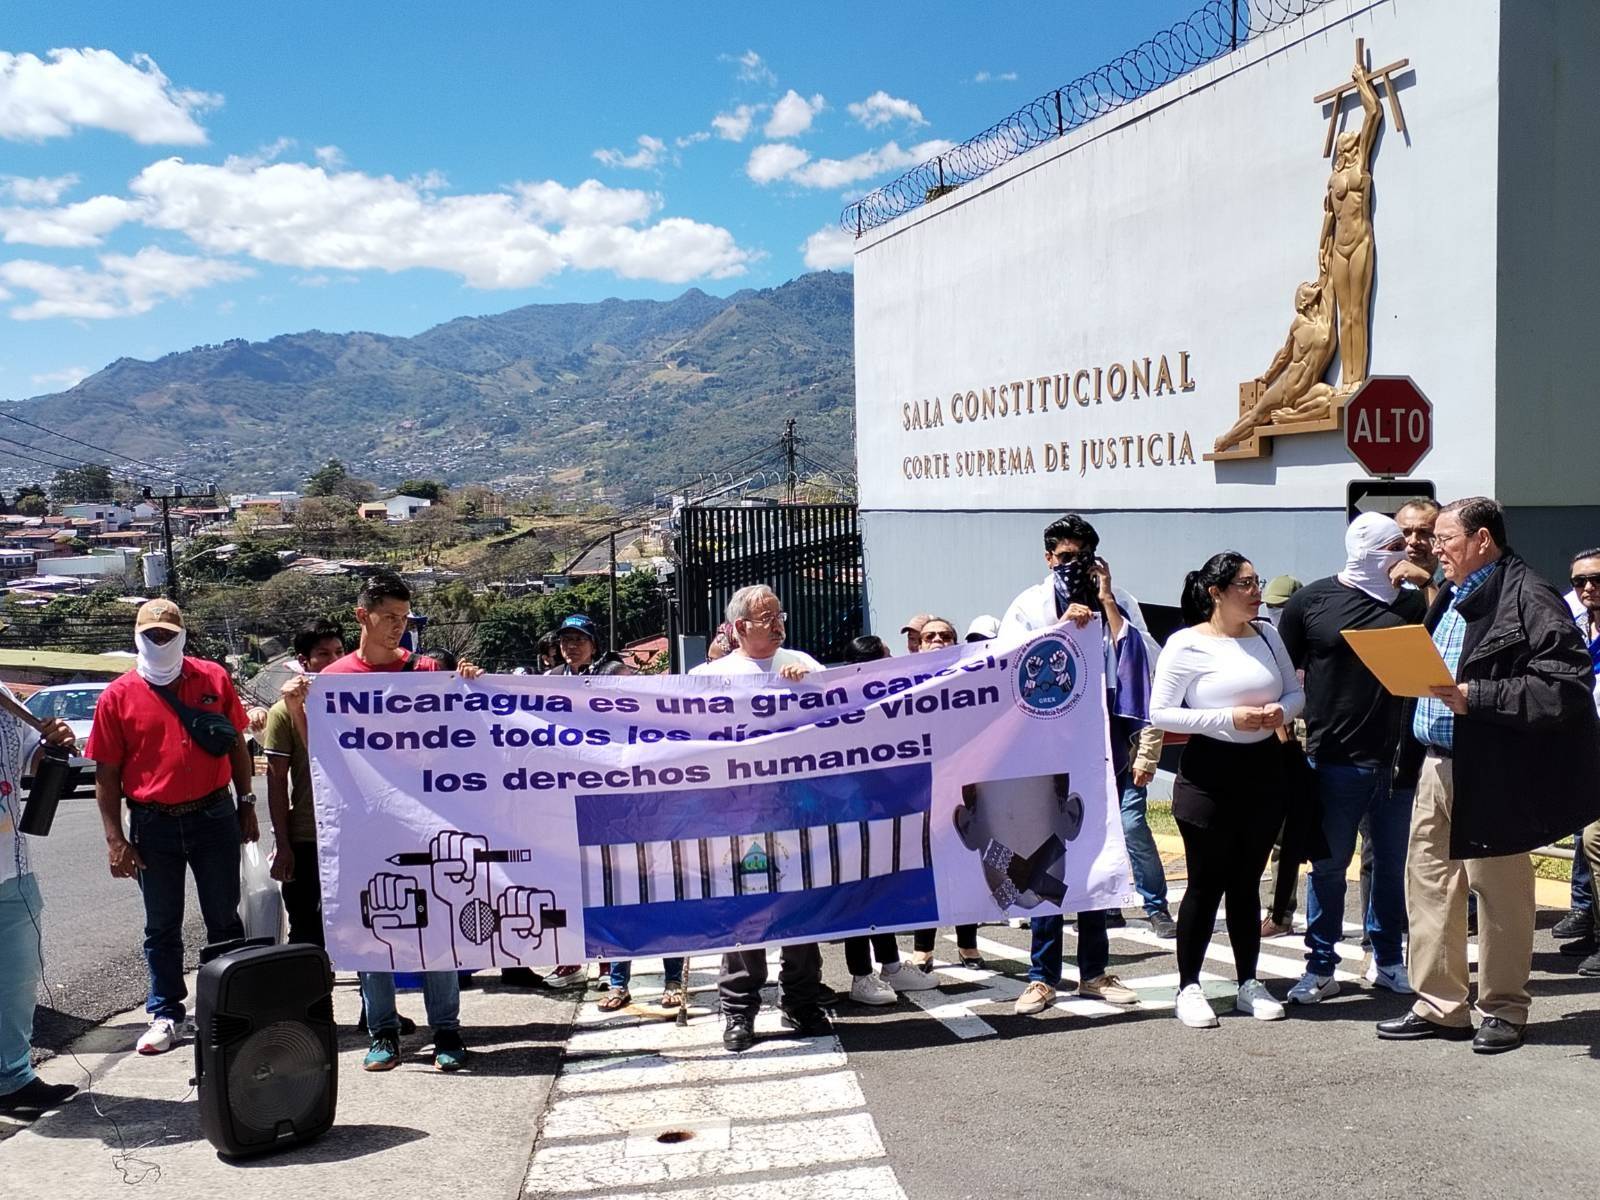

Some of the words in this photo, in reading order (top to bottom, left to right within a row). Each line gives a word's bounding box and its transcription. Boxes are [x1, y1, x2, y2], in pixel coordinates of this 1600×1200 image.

[903, 396, 945, 431] SALA
[951, 351, 1196, 423] CONSTITUCIONAL
[1353, 408, 1425, 443] ALTO
[903, 452, 950, 480] CORTE
[956, 446, 1036, 478] SUPREMA
[1044, 440, 1070, 472] DE
[1080, 430, 1196, 478] JUSTICIA
[325, 690, 573, 716] ¡Nicaragua
[588, 695, 640, 714] es
[656, 694, 735, 714] una
[750, 686, 849, 718] gran
[338, 724, 476, 750] donde
[490, 723, 611, 747] todos
[627, 725, 691, 745] los
[880, 684, 999, 719] violan
[422, 769, 488, 792] los
[502, 764, 711, 790] derechos
[727, 733, 933, 780] humanos!
